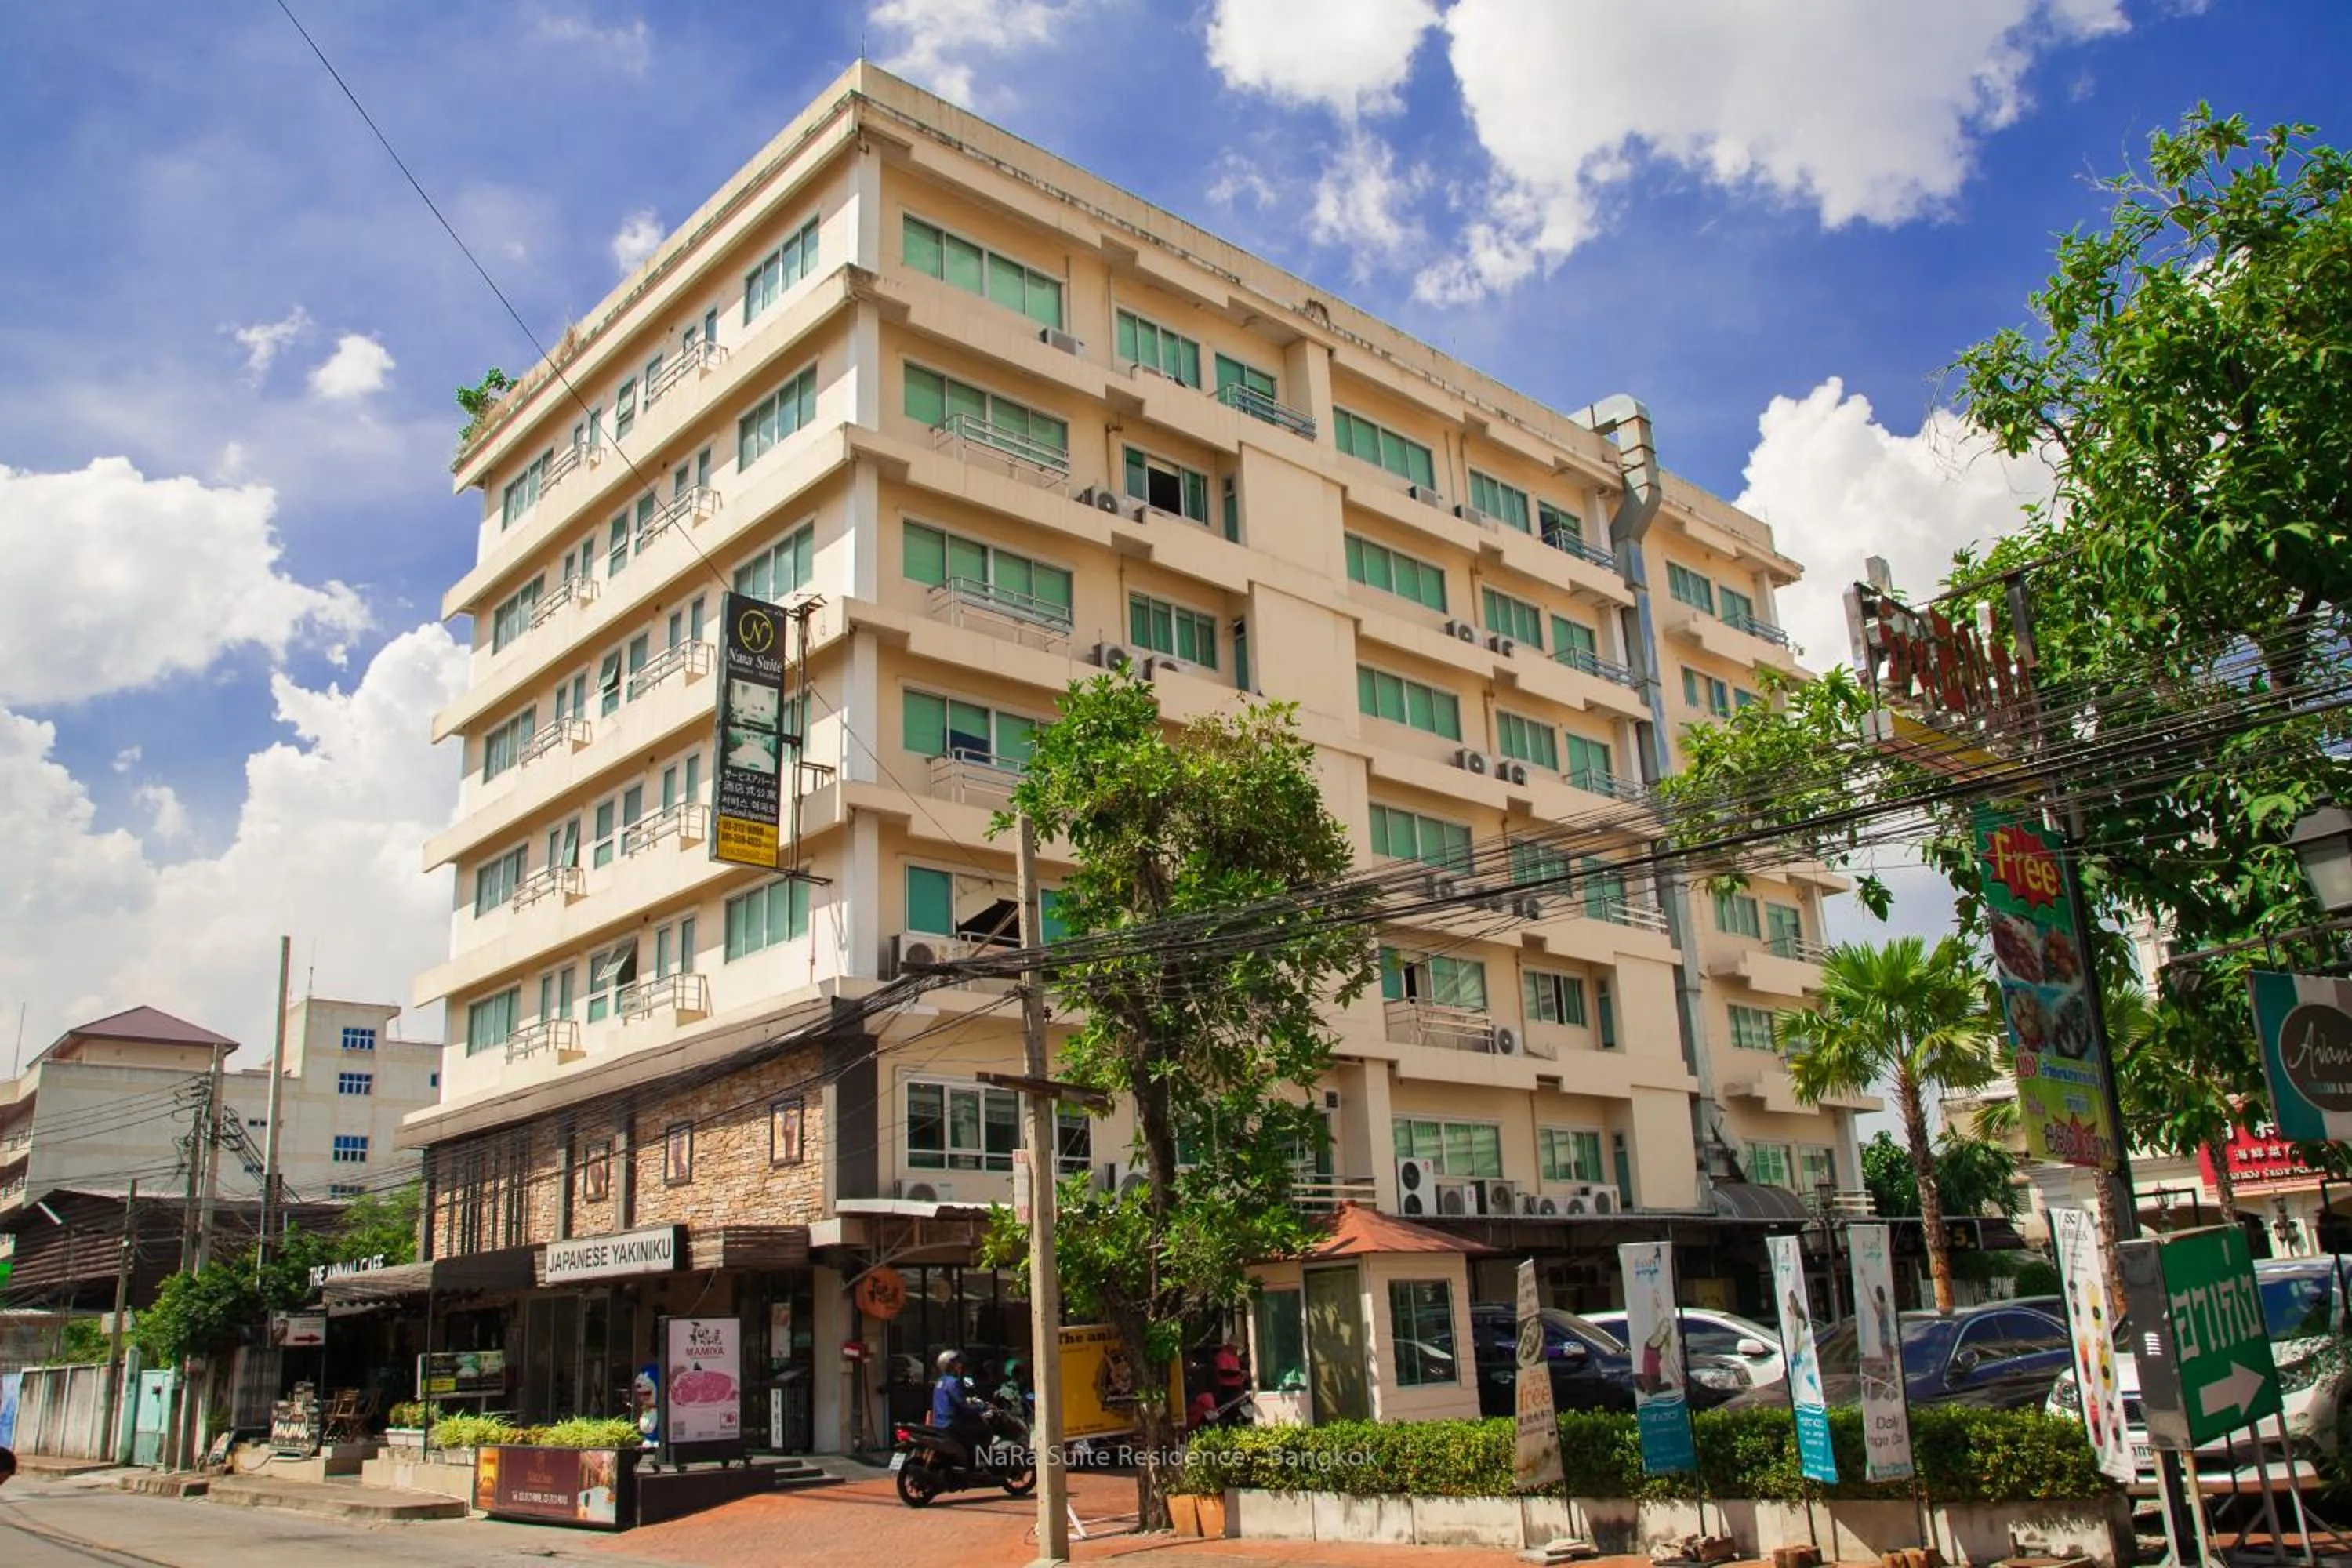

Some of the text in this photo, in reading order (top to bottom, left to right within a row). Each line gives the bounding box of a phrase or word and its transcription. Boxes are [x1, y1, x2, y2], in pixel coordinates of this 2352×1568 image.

[729, 647, 753, 666] Nara
[756, 654, 782, 673] Suite
[1994, 831, 2057, 896] Free
[549, 1237, 671, 1273] JAPANESE YAKINIKU
[309, 1265, 325, 1287] THE
[686, 1344, 725, 1357] MAMIYA
